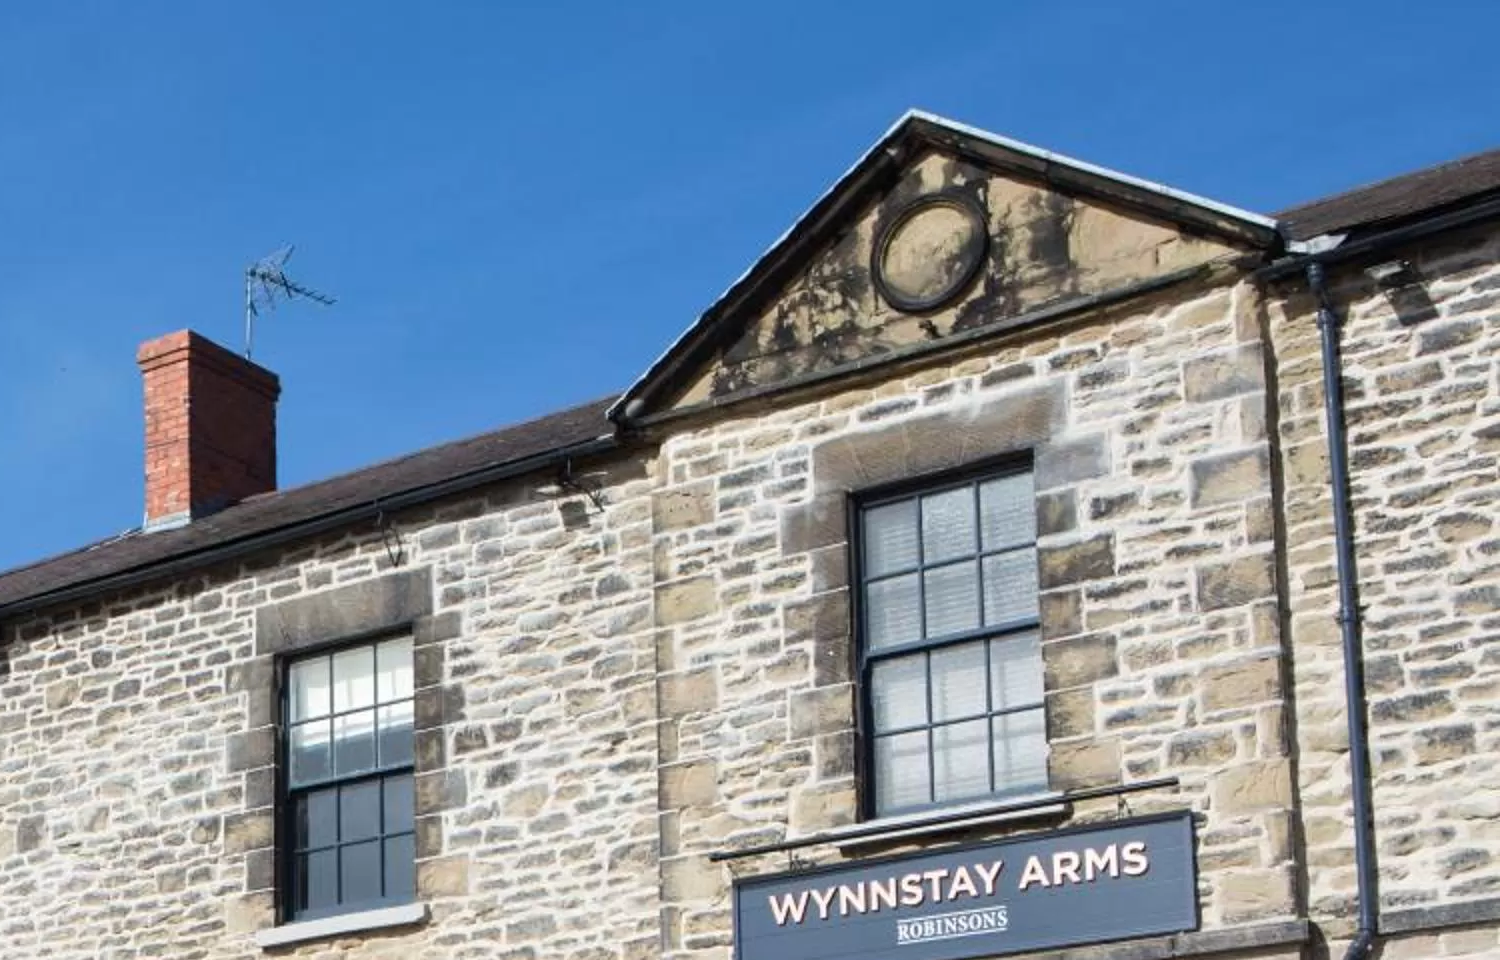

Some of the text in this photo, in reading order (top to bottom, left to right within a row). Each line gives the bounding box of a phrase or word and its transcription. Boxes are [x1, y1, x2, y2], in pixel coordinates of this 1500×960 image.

[768, 841, 1149, 926] WYNNSTAY ARMS
[897, 909, 1009, 942] ROBINSONS
